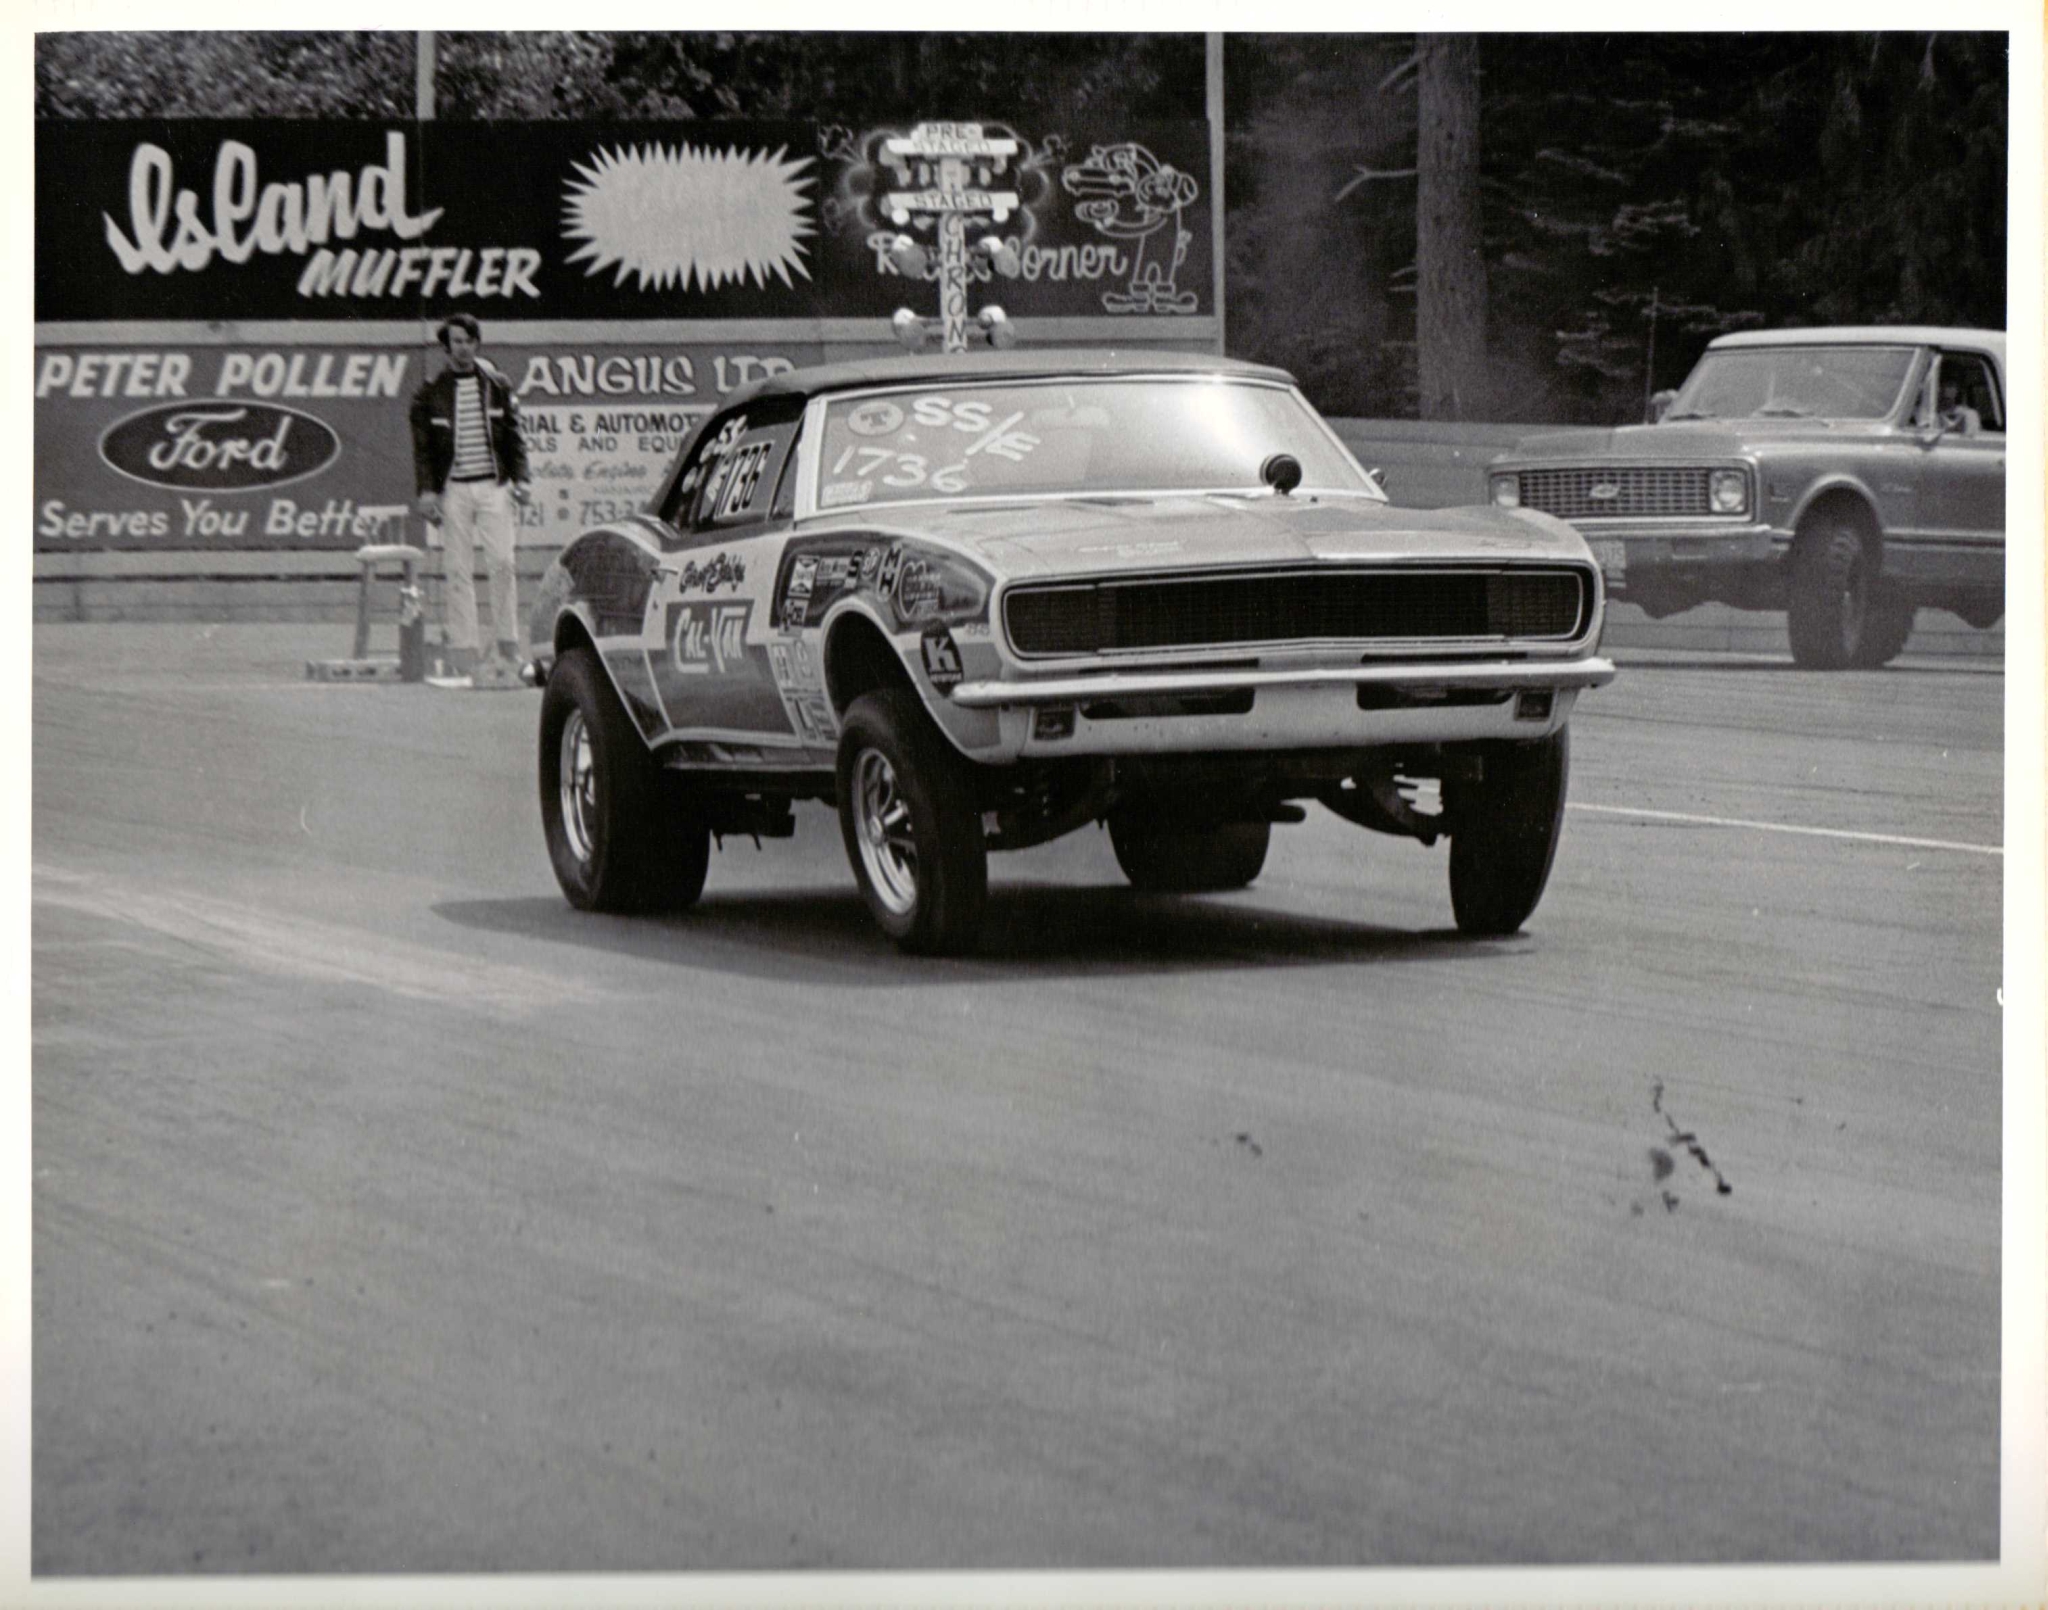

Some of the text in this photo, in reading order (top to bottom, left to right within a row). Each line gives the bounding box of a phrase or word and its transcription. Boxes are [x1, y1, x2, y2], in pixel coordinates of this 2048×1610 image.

[103, 130, 445, 275] Island
[913, 193, 993, 209] STAGED
[297, 247, 541, 298] MUFFLER
[944, 212, 968, 352] CHRON
[36, 353, 408, 398] PETER POLLEN
[516, 354, 697, 396] ANGUS
[148, 407, 293, 471] Ford
[568, 413, 588, 434] &
[577, 436, 619, 453] AND
[831, 447, 969, 494] 1736
[38, 502, 170, 538] Serves
[179, 502, 251, 538] You
[924, 636, 958, 673] K
